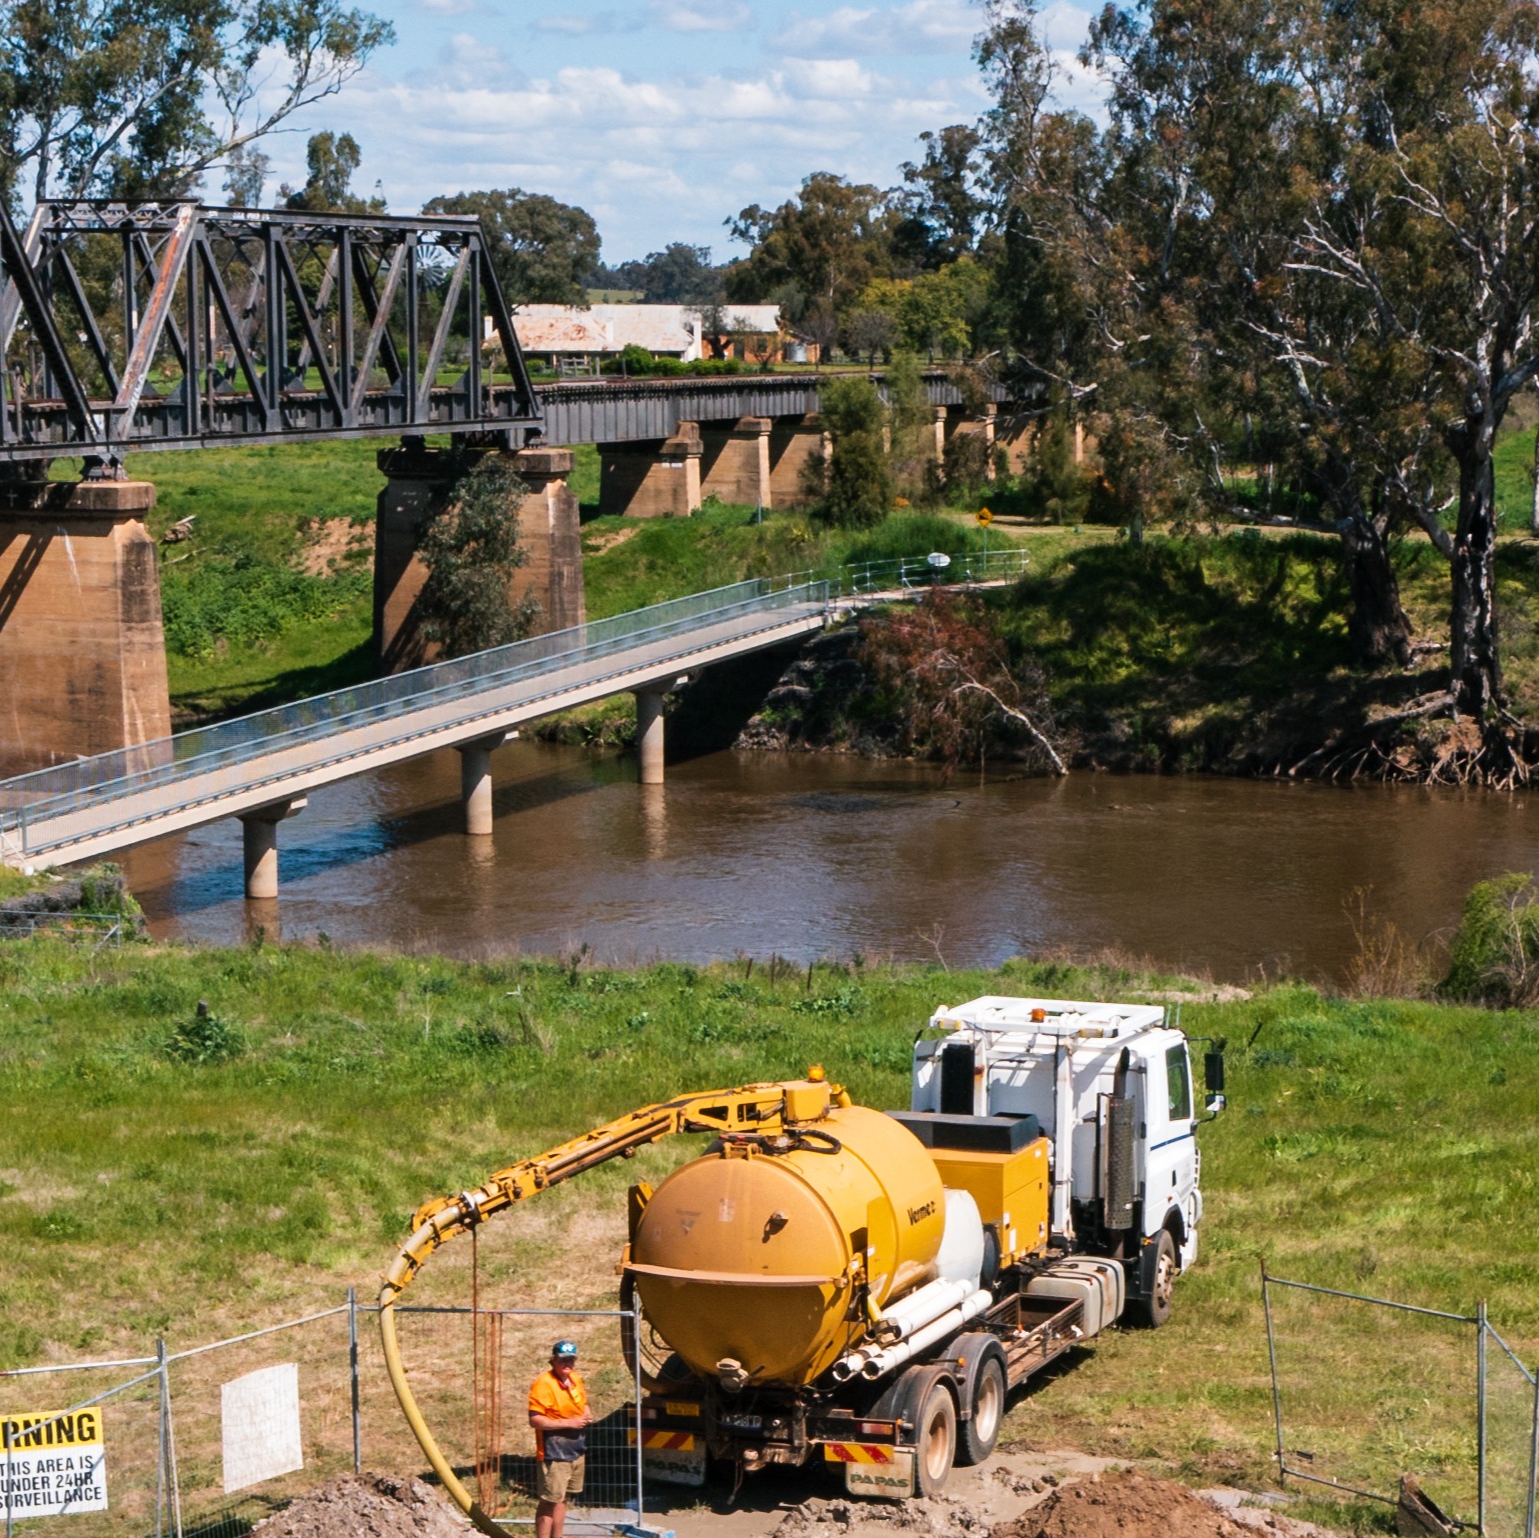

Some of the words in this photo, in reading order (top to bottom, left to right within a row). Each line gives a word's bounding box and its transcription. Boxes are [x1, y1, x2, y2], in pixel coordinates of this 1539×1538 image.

[37, 1457, 74, 1473] AREA
[79, 1455, 93, 1469] IS
[0, 1476, 50, 1493] UNDER
[56, 1472, 94, 1488] 24HR
[850, 1473, 908, 1488] PAPAS
